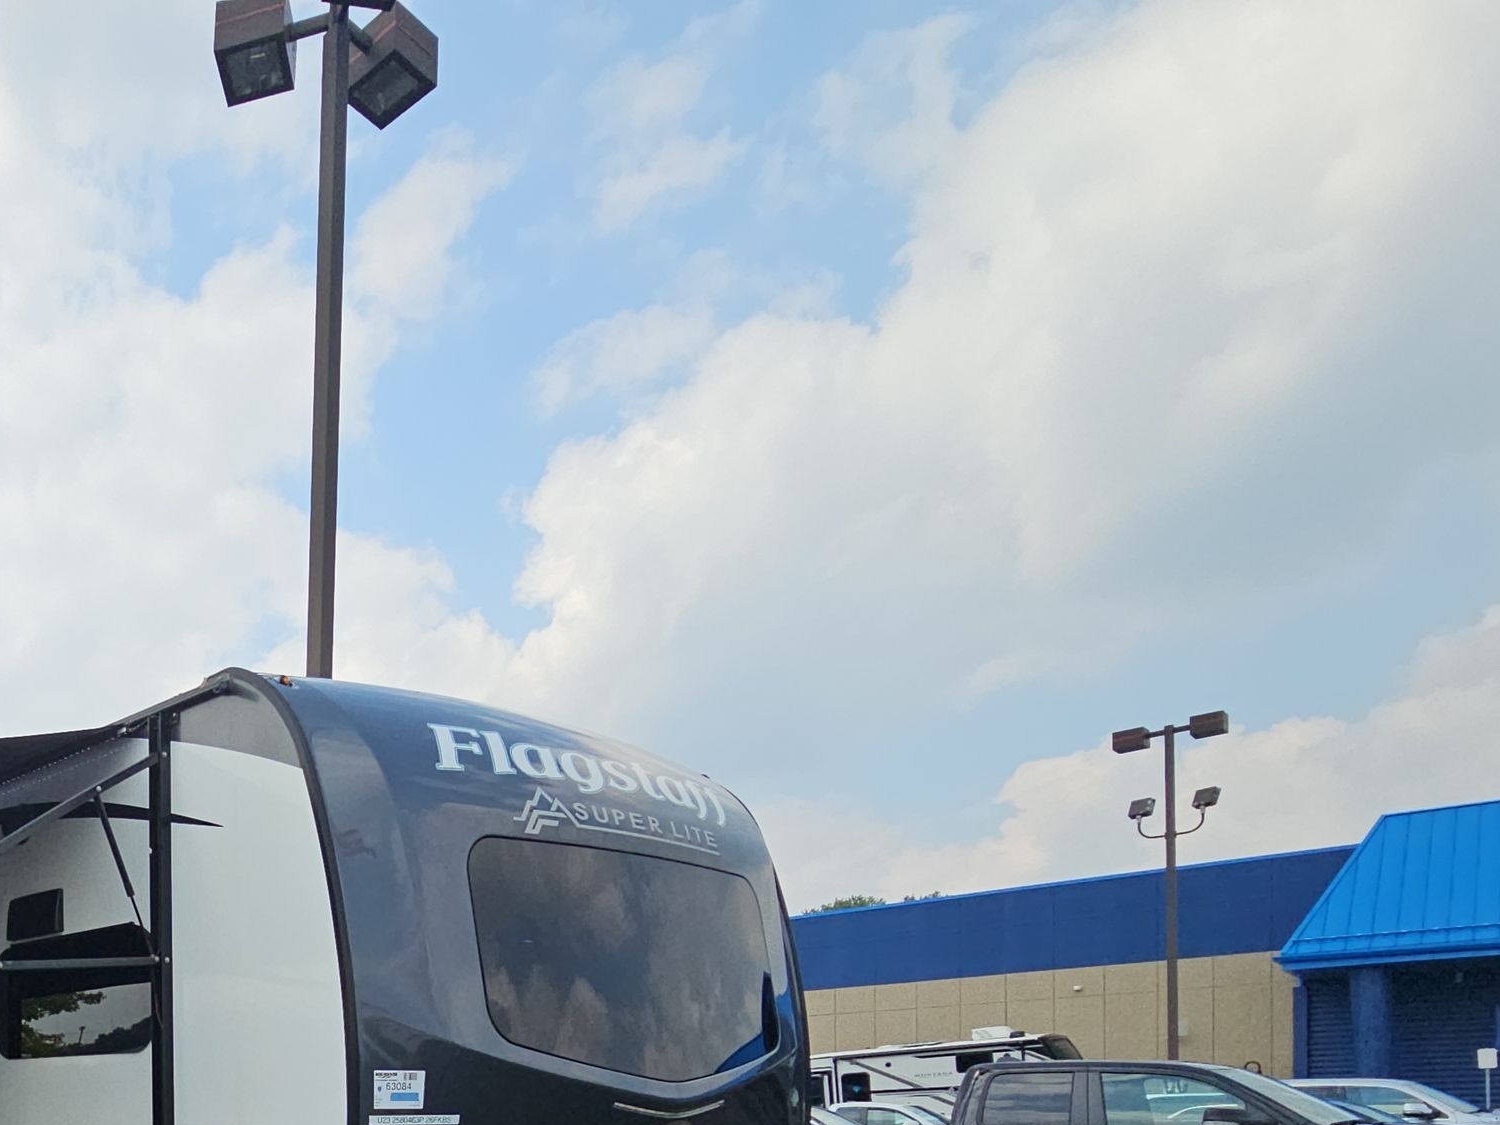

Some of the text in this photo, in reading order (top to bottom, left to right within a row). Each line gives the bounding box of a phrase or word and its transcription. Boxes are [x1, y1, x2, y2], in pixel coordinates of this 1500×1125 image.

[427, 722, 727, 828] Flagstaff
[574, 802, 719, 849] SUPER LITE
[385, 1081, 412, 1091] 63084
[377, 1116, 390, 1124] U23
